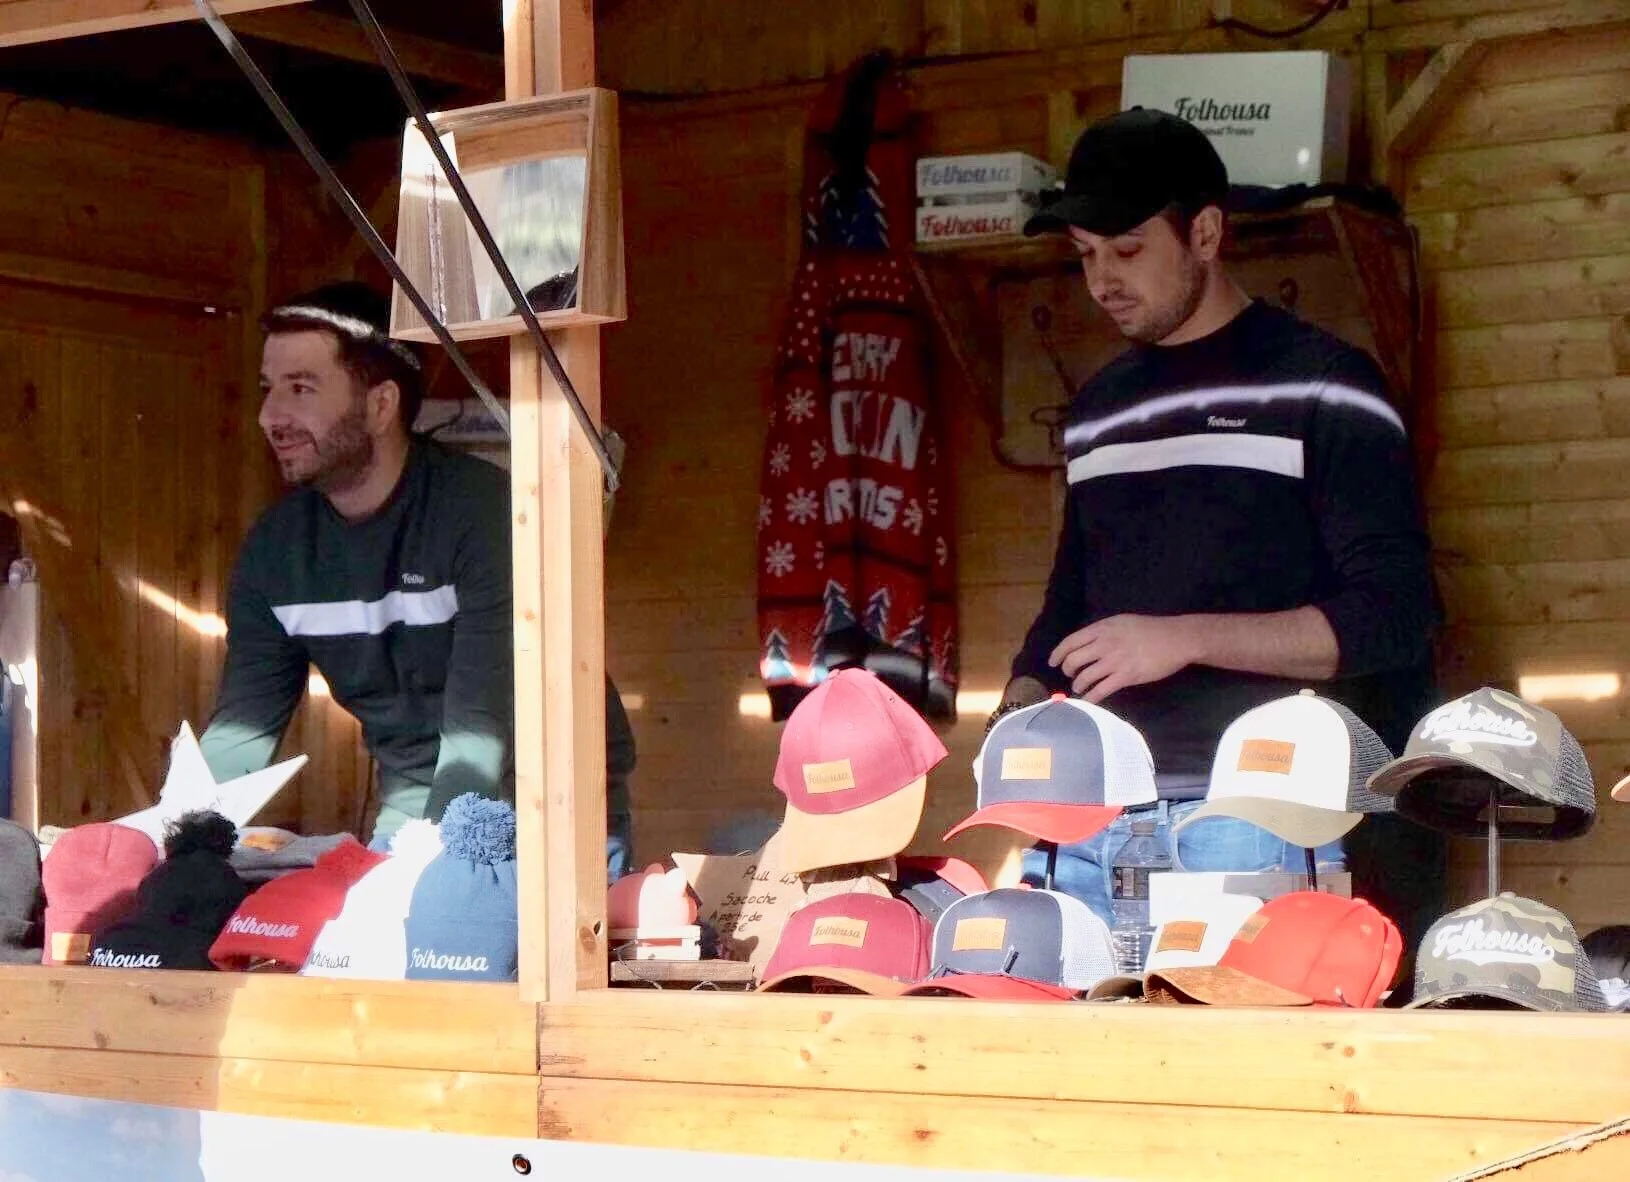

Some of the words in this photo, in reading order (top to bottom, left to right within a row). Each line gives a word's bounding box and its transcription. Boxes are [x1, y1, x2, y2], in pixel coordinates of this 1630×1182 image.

[1174, 97, 1271, 121] Folhousa
[921, 215, 1012, 237] Folhousa
[1420, 702, 1535, 744] Folhousa
[226, 916, 299, 938] Folhousa
[814, 925, 861, 939] Folhousa
[1432, 918, 1553, 962] Folhousa
[406, 947, 490, 972] Folhousa
